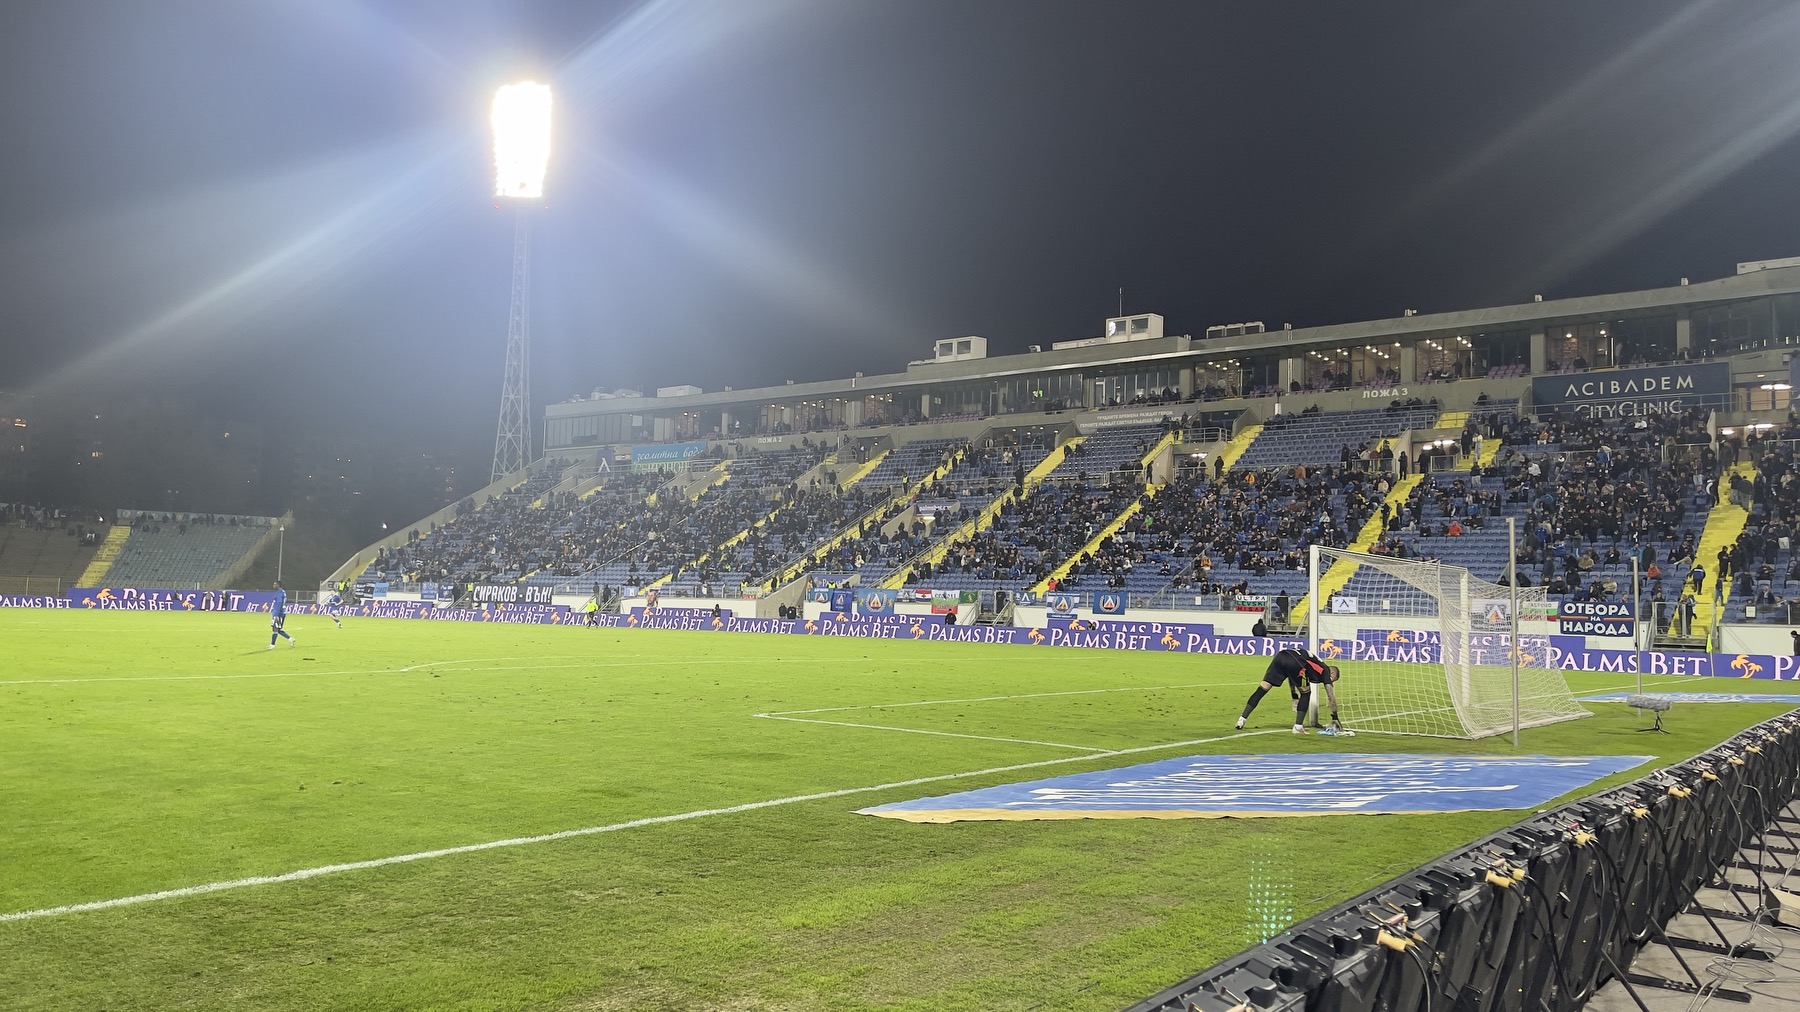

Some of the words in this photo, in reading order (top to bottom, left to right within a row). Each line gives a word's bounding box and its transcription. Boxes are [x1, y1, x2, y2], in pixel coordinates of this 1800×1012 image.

[1362, 388, 1399, 399] ЛОЖА
[1401, 388, 1408, 396] 3
[1565, 374, 1694, 397] ACIBADEM
[473, 585, 517, 602] СИРАКОВ
[525, 586, 553, 603] ВЪН!
[45, 596, 72, 609] BET
[101, 597, 145, 611] PALMS
[148, 599, 174, 611] BET
[293, 603, 308, 614] BET
[1564, 603, 1630, 616] ОТБОРА
[343, 605, 359, 617] BET
[370, 606, 398, 619] PALMS
[397, 607, 416, 620] BET
[429, 608, 459, 621] PALMS
[459, 609, 477, 622] BET
[492, 609, 524, 624] PALMS
[523, 611, 545, 625] BET
[598, 613, 621, 628] BET
[640, 614, 678, 631] PALMS
[680, 616, 704, 631] BET
[726, 617, 768, 634] PALMS
[770, 619, 796, 635] BET
[1563, 621, 1630, 636] НАРОДА
[822, 620, 869, 638] PALMS
[871, 622, 901, 639] BET
[929, 623, 980, 643] PALMS
[984, 626, 1017, 644] BET
[1050, 628, 1111, 649] PALMS
[1115, 632, 1152, 651] BET
[1187, 633, 1256, 655] PALMS
[1350, 639, 1432, 663] PALMS
[1544, 646, 1638, 673] PALMS
[1648, 652, 1708, 677] BET
